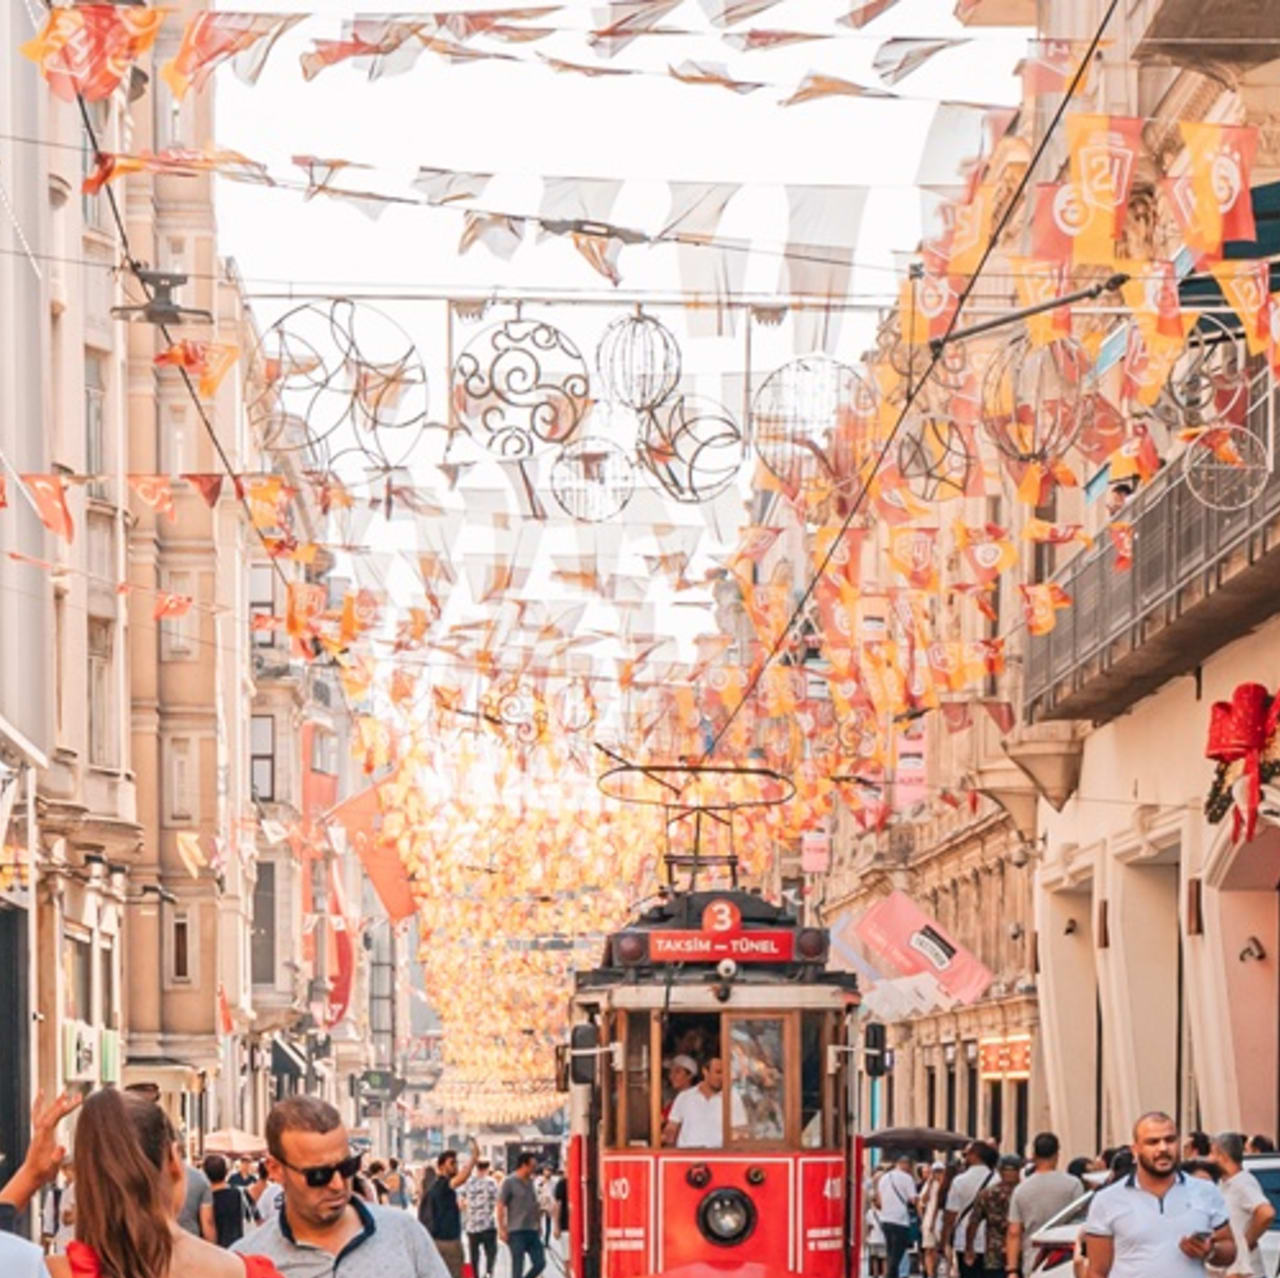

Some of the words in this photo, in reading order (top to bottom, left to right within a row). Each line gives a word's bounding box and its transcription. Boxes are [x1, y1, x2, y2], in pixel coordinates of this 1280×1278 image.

[711, 902, 733, 932] 3
[656, 937, 711, 952] TAKSİM
[730, 937, 779, 953] TÜNEL
